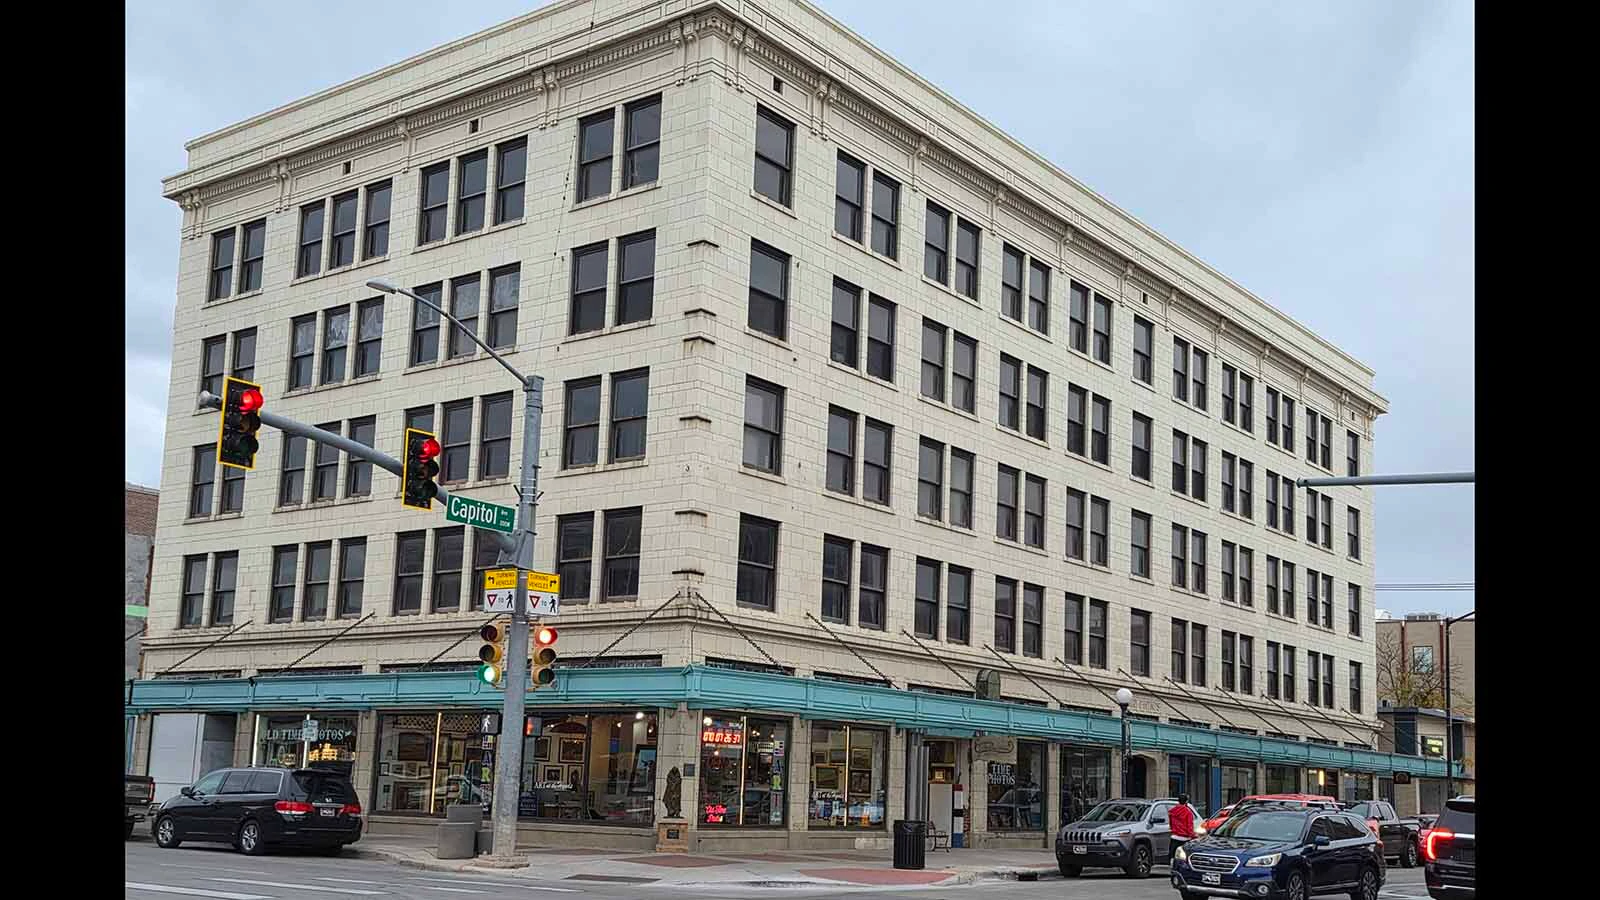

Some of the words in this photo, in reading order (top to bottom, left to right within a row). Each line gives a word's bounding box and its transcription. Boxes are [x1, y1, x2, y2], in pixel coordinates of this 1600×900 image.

[451, 497, 498, 524] Capitol
[991, 763, 1011, 774] TIME
[988, 773, 1016, 785] PHOTOS
